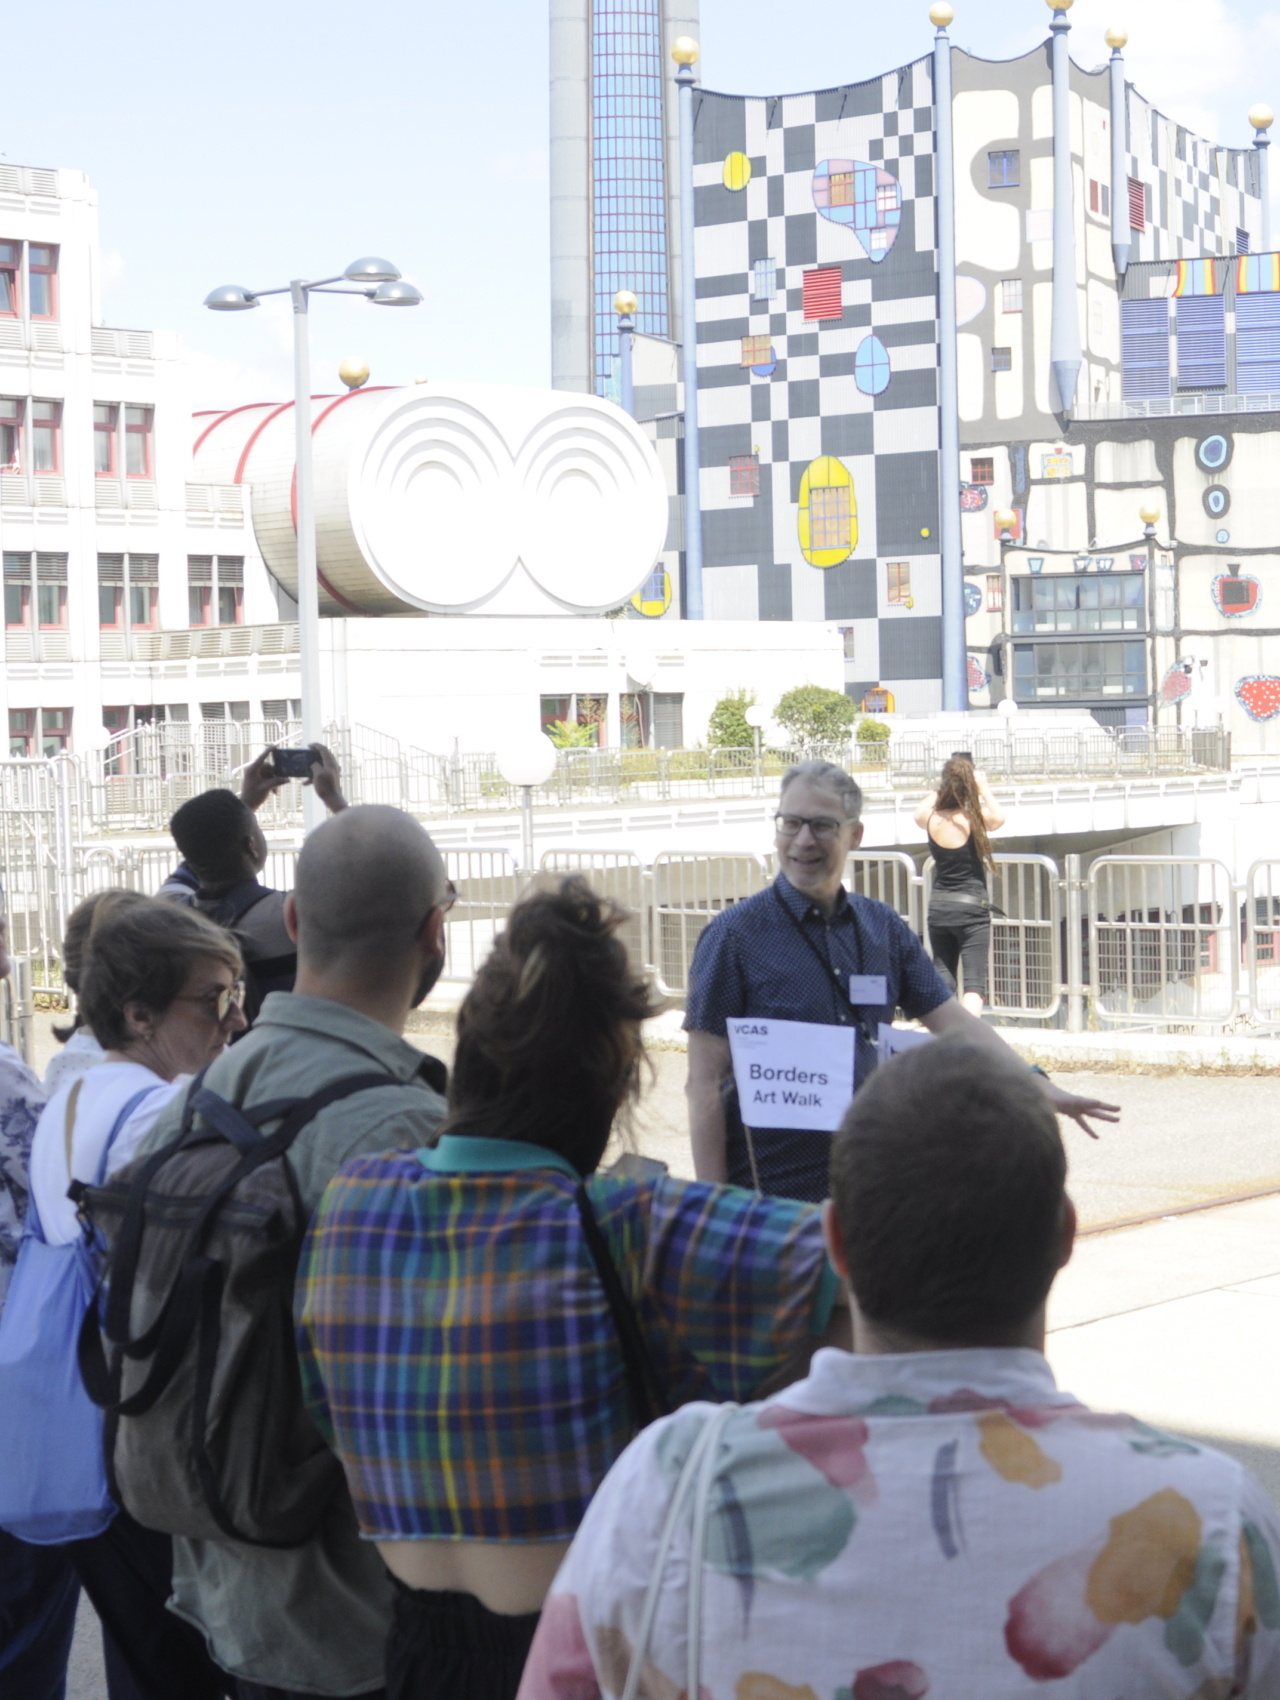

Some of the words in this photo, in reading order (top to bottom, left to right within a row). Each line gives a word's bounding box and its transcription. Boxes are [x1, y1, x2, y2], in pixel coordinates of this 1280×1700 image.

[734, 1024, 768, 1036] VCAS
[749, 1063, 828, 1085] Borders
[753, 1090, 777, 1105] Art
[782, 1091, 823, 1108] Walk
